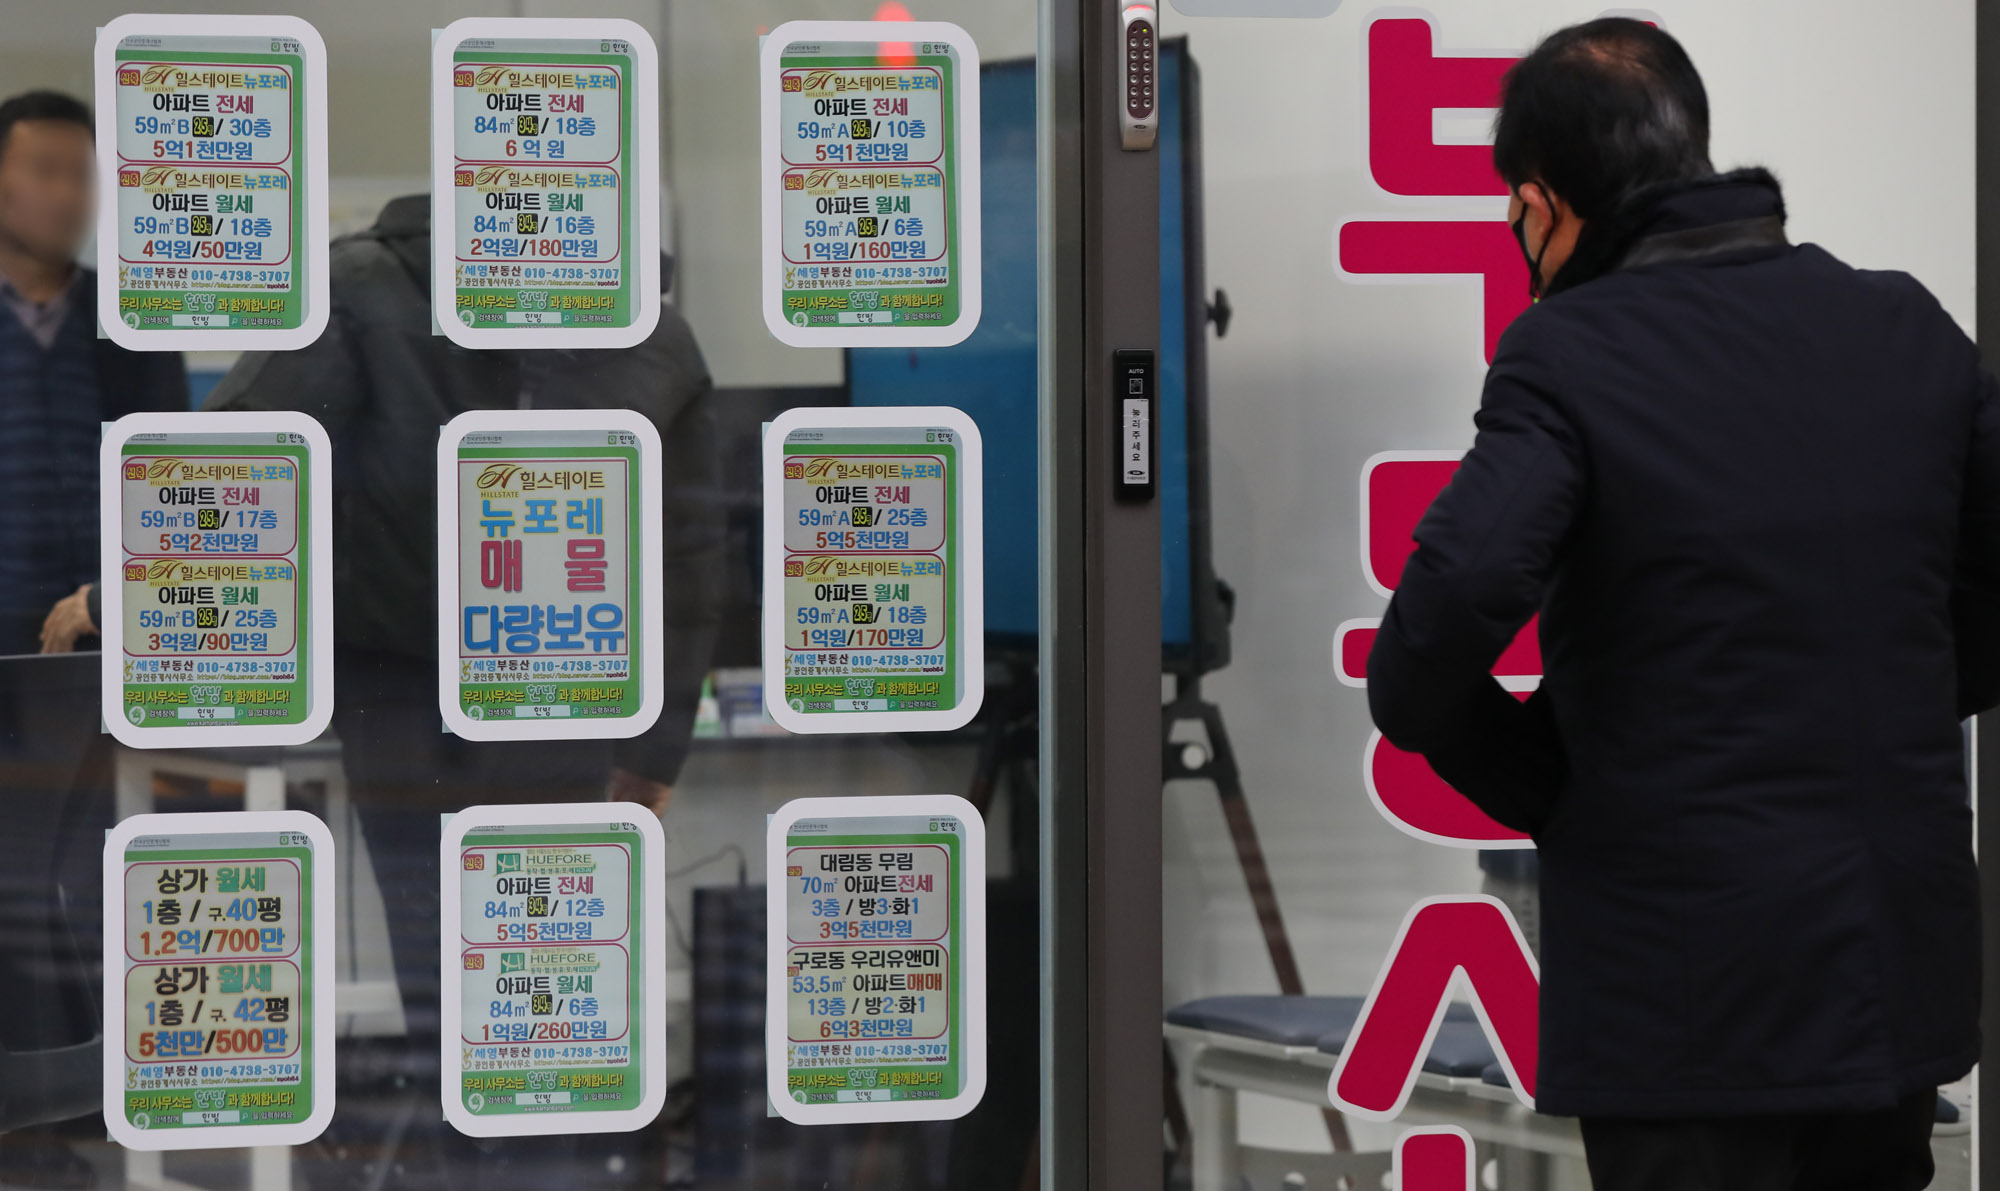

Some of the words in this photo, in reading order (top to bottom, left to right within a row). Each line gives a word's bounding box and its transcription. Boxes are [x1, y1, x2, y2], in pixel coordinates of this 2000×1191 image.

[176, 73, 287, 89] 힐스테이트뉴포레
[509, 73, 616, 89] 힐스테이트뉴포레
[835, 76, 938, 91] 힐스테이트뉴포레
[153, 94, 210, 112] 아파트
[216, 95, 254, 114] 전세
[487, 94, 542, 112] 아파트
[548, 95, 584, 112] 전세
[815, 99, 867, 116] 아파트
[873, 98, 908, 116] 전세
[230, 119, 271, 138] 30층
[556, 117, 596, 136] 18층
[175, 173, 287, 190] 힐스테이트뉴포레
[509, 173, 616, 188] 힐스테이트뉴포레
[837, 174, 941, 189] 힐스테이트뉴포레
[153, 194, 209, 212] 아파트
[216, 195, 253, 213] 월세
[486, 193, 541, 211] 아파트
[547, 193, 583, 211] 월세
[816, 197, 869, 215] 아파트
[876, 196, 910, 214] 월세
[556, 216, 595, 235] 16층
[895, 217, 923, 236] 6층
[143, 240, 262, 260] 4억원/50만원
[471, 238, 598, 257] 2억원/180만원
[804, 241, 926, 260] 1억원/160만원
[131, 267, 188, 279] 세영부동산
[192, 270, 289, 282] 010-4738-3707
[465, 265, 521, 276] 세영부동산
[525, 268, 619, 279] 010-4738-3707
[798, 267, 852, 278] 세영부동산
[855, 267, 947, 278] 010-4738-3707
[119, 297, 139, 311] 우리
[142, 297, 182, 311] 사무소는
[184, 293, 216, 311] 한방
[218, 299, 228, 311] 과
[231, 299, 285, 312] 함께합니다!
[192, 316, 209, 325] 한방
[182, 465, 293, 480] 힐스테이트뉴포레
[520, 472, 604, 490] 힐스테이트
[837, 465, 941, 479] 힐스테이트뉴포레
[159, 487, 216, 505] 아파트
[222, 487, 259, 505] 전세
[816, 486, 869, 504] 아파트
[875, 486, 910, 504] 전세
[237, 510, 277, 529] 17층
[480, 498, 603, 537] 뉴포레
[160, 533, 258, 552] 5억2천만원
[817, 531, 909, 549] 5억5천만원
[181, 566, 292, 581] 힐스테이트뉴포레
[836, 562, 941, 576] 힐스테이트뉴포레
[159, 586, 215, 605] 아파트
[221, 586, 259, 605] 월세
[815, 584, 868, 602] 아파트
[874, 584, 909, 602] 월세
[464, 603, 624, 653] 다량보유
[149, 633, 268, 651] 3억원/90만원
[801, 628, 923, 647] 1억원/170만원
[136, 660, 194, 671] 세영부동산
[197, 662, 295, 672] 010-4738-3707
[474, 660, 529, 671] 세영부동산
[533, 660, 627, 672] 010-4738-3707
[794, 654, 848, 665] 세영부동산
[852, 655, 944, 666] 010-4738-3707
[463, 690, 483, 703] 우리
[485, 690, 525, 703] 사무소는
[526, 685, 557, 702] 한방
[559, 690, 569, 701] 과
[572, 689, 623, 702] 함께합니다!
[526, 854, 592, 864] HUEFORE
[821, 853, 872, 872] 대림동
[879, 853, 913, 871] 무림
[157, 868, 208, 894] 상가
[216, 867, 266, 893] 월세
[497, 877, 551, 895] 아파트
[558, 876, 594, 895] 전세
[566, 899, 604, 917] 12층
[812, 899, 840, 917] 3층
[497, 922, 592, 941] 5억5천만원
[820, 920, 912, 939] 3억5천만원
[141, 928, 285, 956] 1.2억/700만
[531, 953, 596, 964] HUEFORE
[793, 952, 845, 970] 구로동
[851, 950, 939, 969] 우리유앤미
[155, 966, 209, 995] 상가
[218, 965, 271, 993] 월세
[496, 977, 550, 995] 아파트
[557, 975, 592, 994] 월세
[569, 998, 598, 1016] 6층
[808, 998, 846, 1016] 13층
[482, 1021, 607, 1041] 1억원/260만원
[821, 1019, 912, 1038] 6억3천만원
[139, 1028, 288, 1057] 5천만/500만
[798, 1045, 851, 1056] 세영부동산
[855, 1045, 947, 1056] 010-4738-3707
[475, 1047, 531, 1059] 세영부동산
[534, 1046, 628, 1058] 010-4738-3707
[141, 1066, 198, 1078] 세영부동산
[202, 1064, 299, 1077] 010-4738-3707
